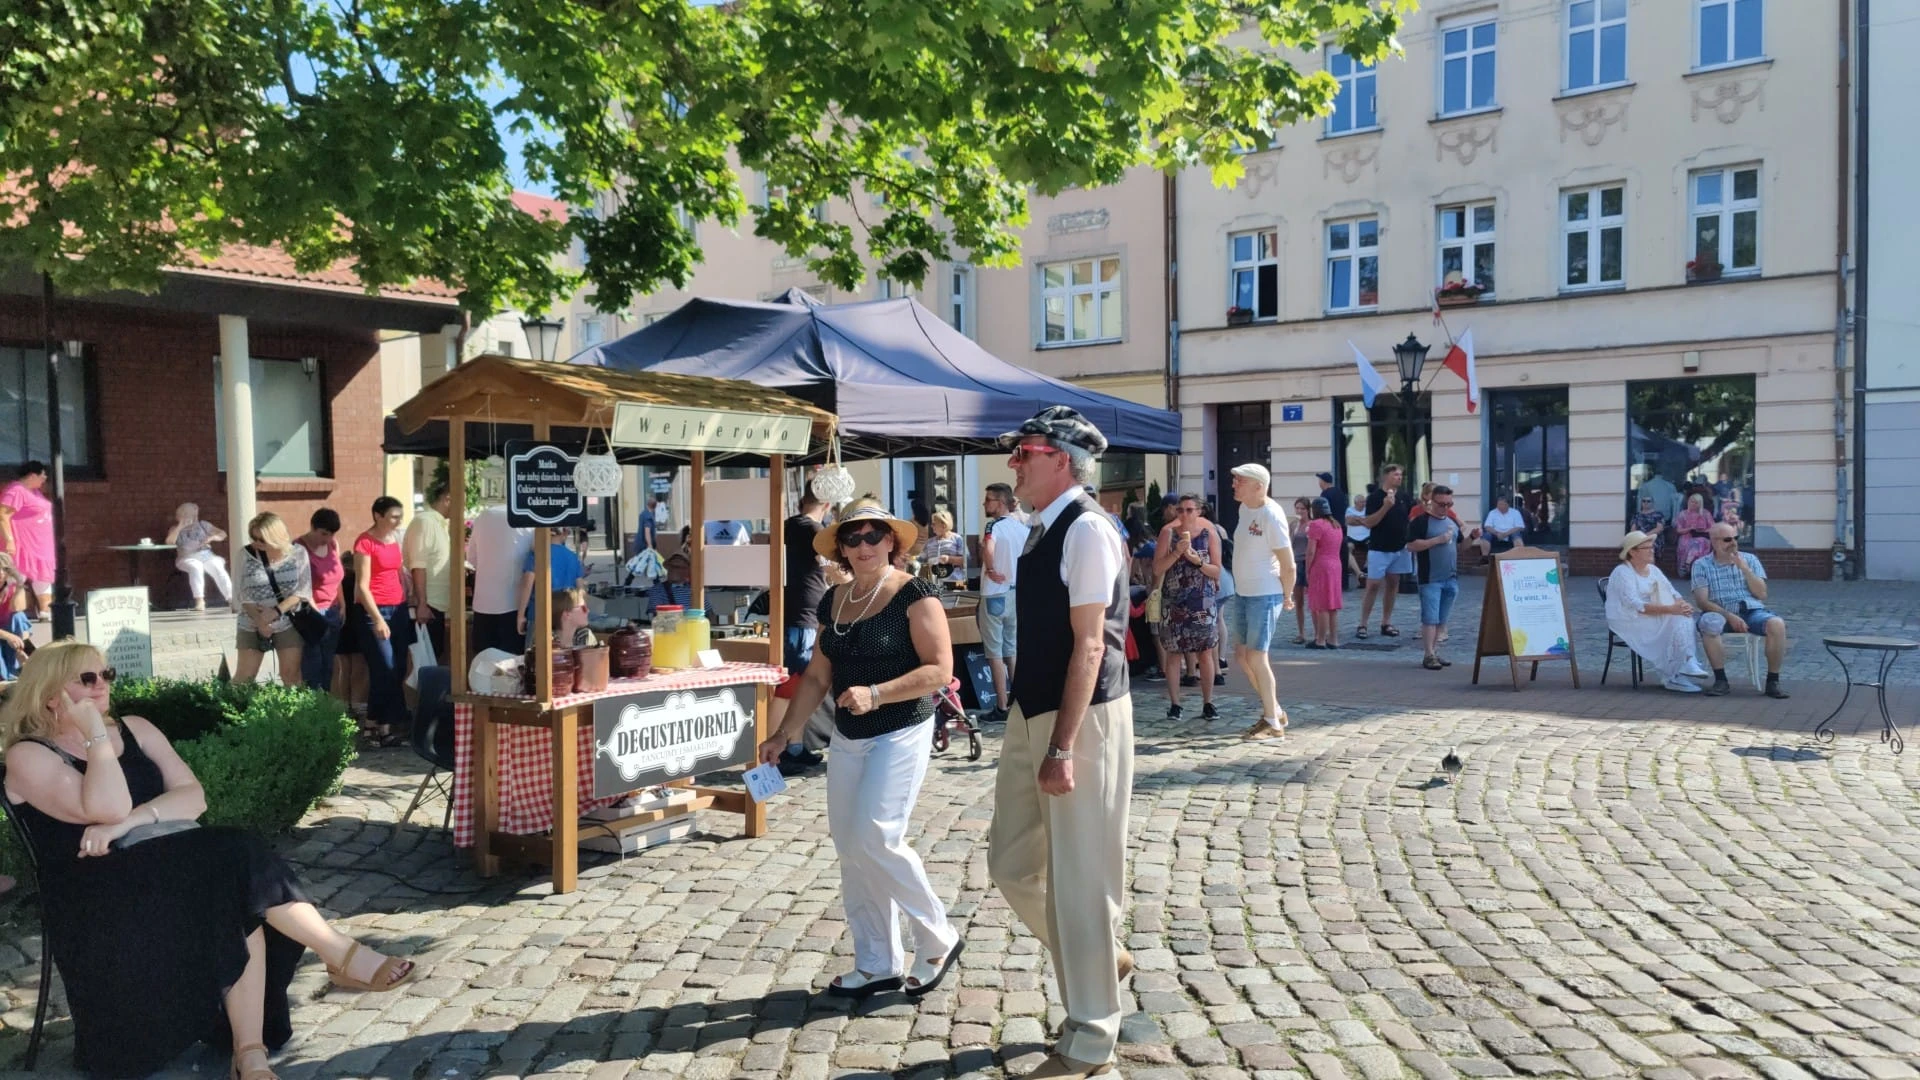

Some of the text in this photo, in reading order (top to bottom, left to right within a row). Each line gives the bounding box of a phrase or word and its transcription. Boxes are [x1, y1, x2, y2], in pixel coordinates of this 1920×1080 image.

[1290, 410, 1296, 419] 7
[639, 417, 788, 441] Wejherowo
[527, 496, 548, 506] Cukier
[617, 710, 738, 757] DEGUSTATORNIA
